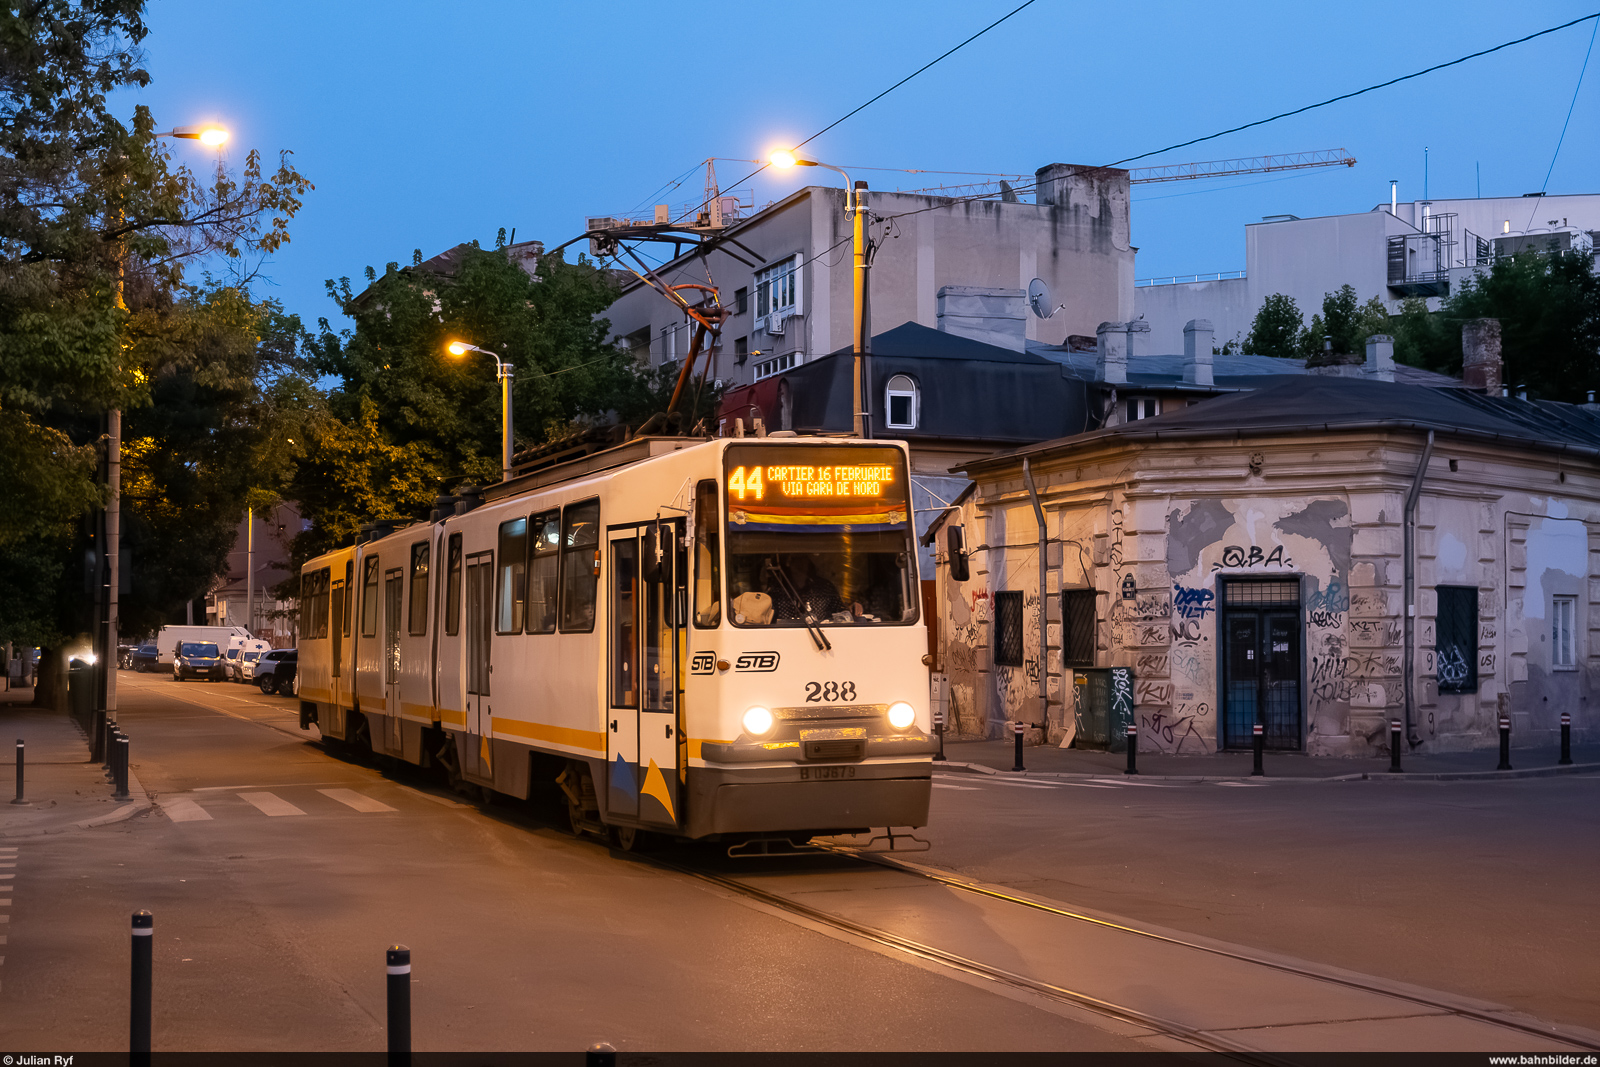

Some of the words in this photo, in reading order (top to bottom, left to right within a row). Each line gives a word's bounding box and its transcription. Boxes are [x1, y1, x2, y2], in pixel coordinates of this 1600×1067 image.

[767, 466, 815, 481] CARTIER
[818, 466, 832, 481] 16
[834, 466, 893, 481] FEBRUARIE
[729, 466, 762, 499] 44
[782, 482, 804, 496] VIA
[806, 482, 833, 496] GARA
[836, 482, 850, 496] DE
[853, 482, 881, 496] NORD
[1222, 545, 1284, 568] QBA
[691, 656, 714, 671] STB
[735, 656, 776, 669] STB
[804, 681, 858, 703] 288
